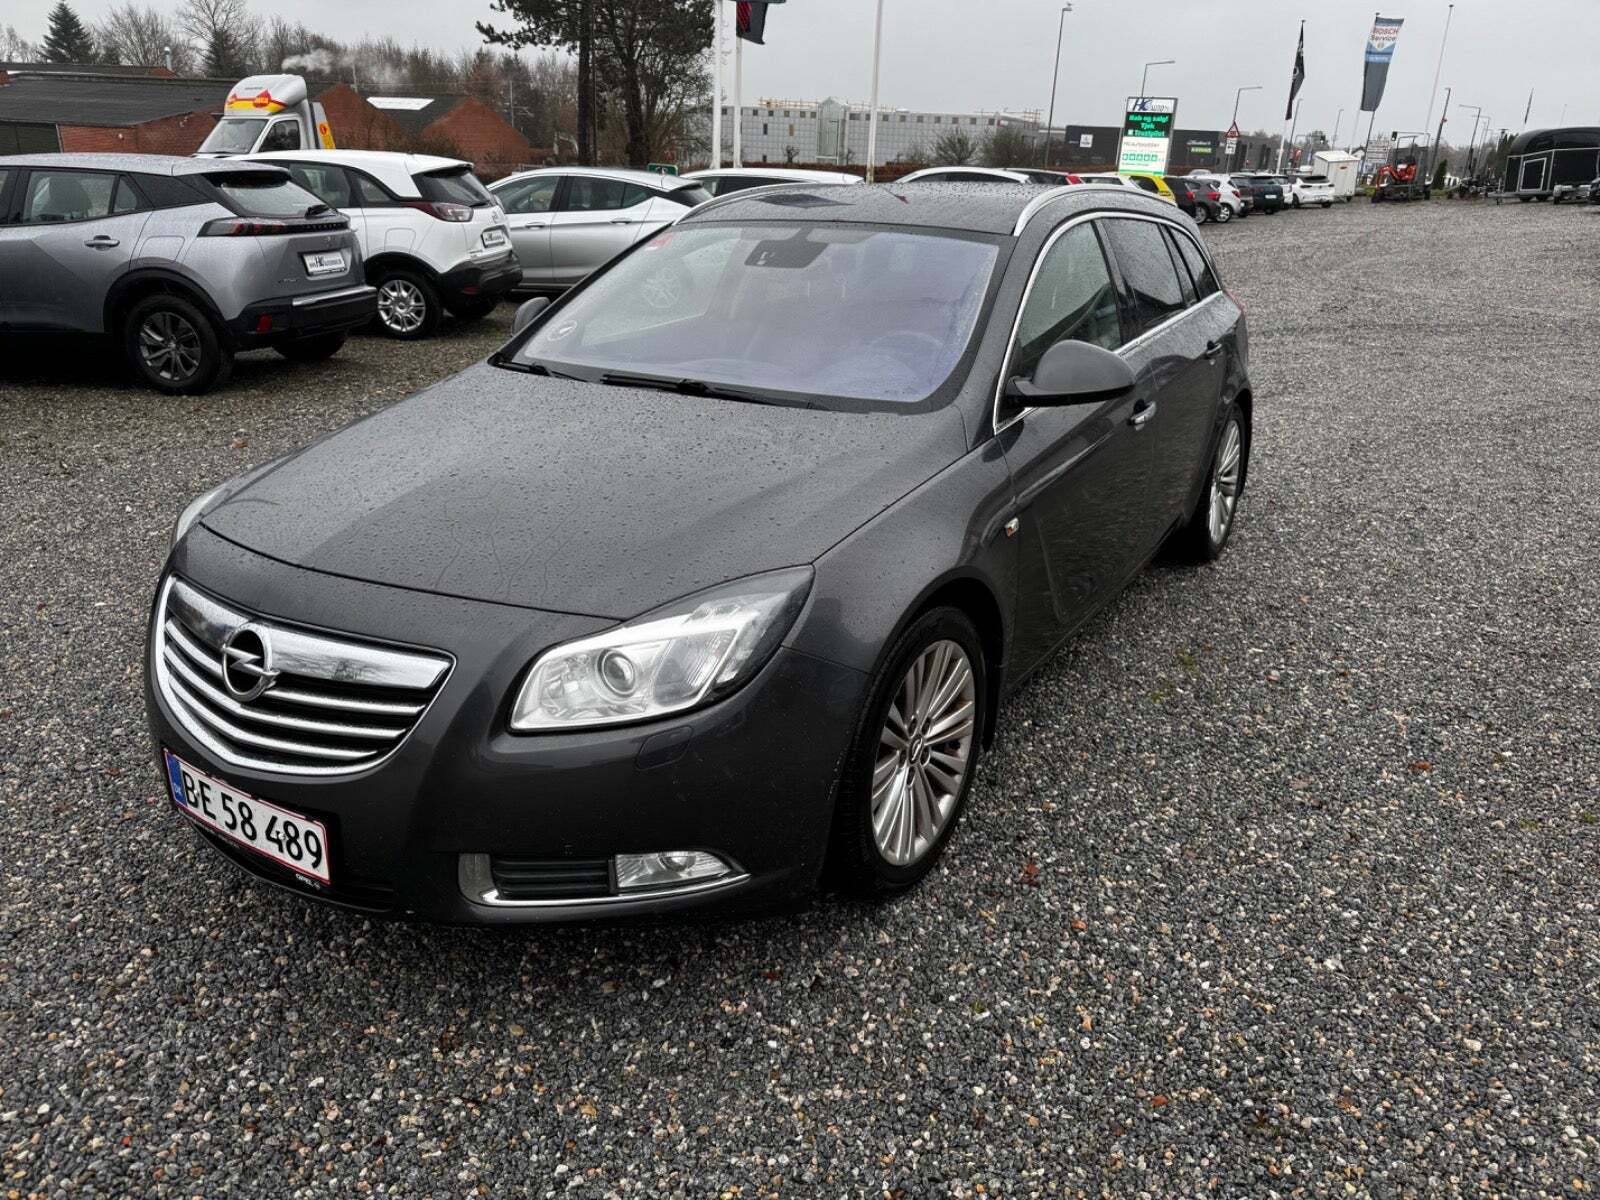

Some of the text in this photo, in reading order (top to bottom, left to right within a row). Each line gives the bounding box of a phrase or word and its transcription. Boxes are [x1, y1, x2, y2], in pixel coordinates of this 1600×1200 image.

[181, 770, 217, 821] BE
[220, 791, 258, 841] 58
[264, 815, 323, 869] 489
[295, 873, 314, 887] OPEL
